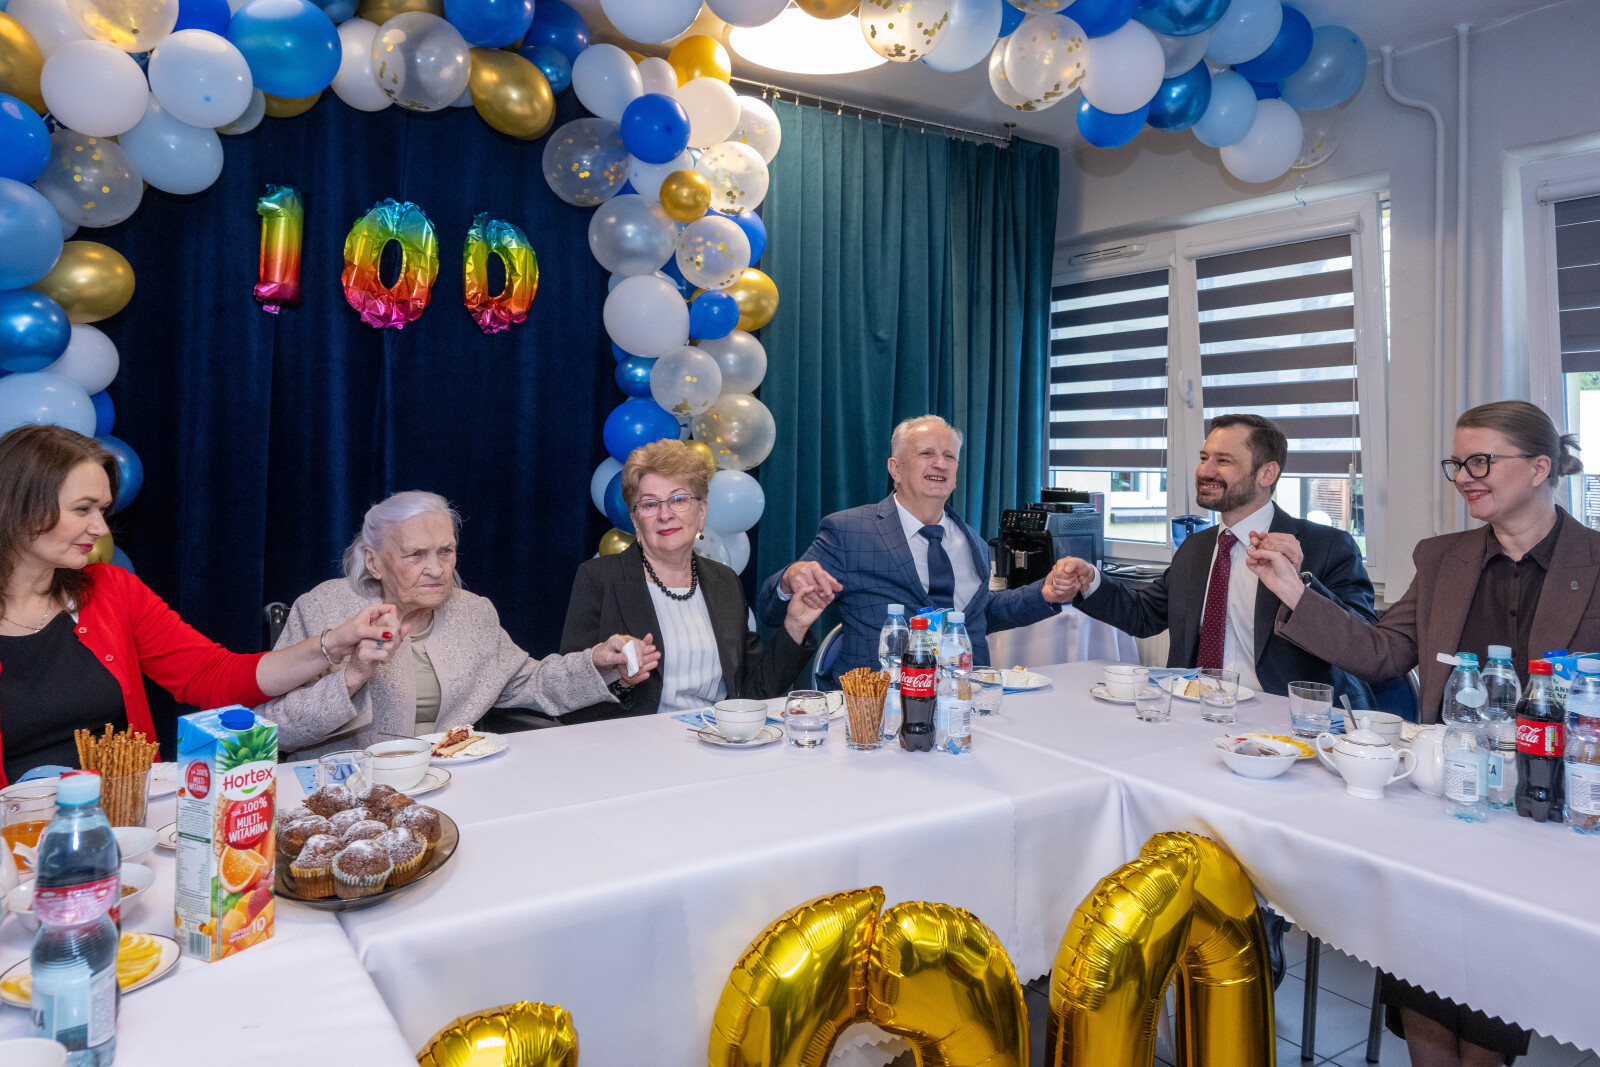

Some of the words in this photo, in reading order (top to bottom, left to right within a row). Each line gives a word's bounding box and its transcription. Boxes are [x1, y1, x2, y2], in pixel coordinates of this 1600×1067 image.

[222, 766, 274, 792] Hortex
[242, 796, 268, 815] 100%
[236, 812, 263, 830] MULTI-
[228, 821, 269, 844] WITAMINA
[250, 916, 266, 934] 10
